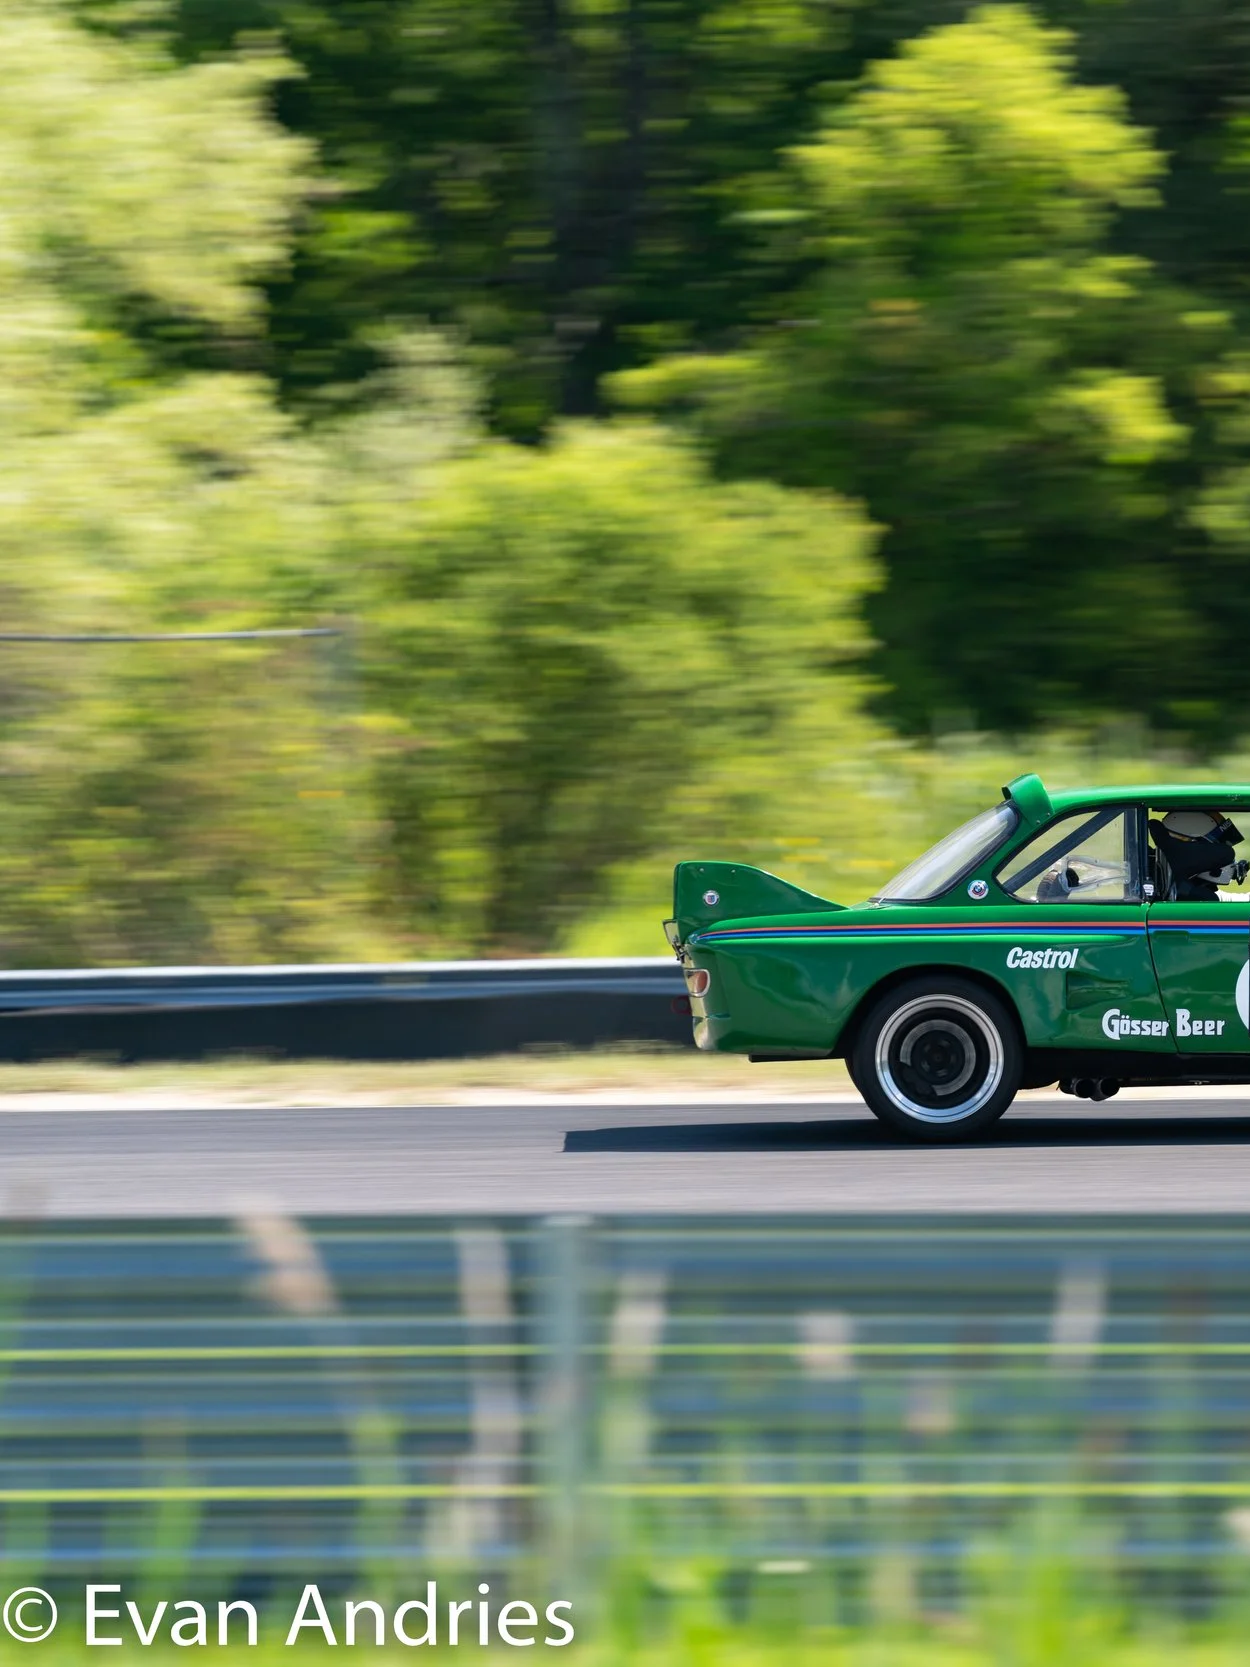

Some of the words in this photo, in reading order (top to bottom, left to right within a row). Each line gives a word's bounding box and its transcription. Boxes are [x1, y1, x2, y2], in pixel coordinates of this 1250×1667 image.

[1006, 946, 1079, 969] Castrol
[1101, 1008, 1170, 1041] Gösser
[1175, 1008, 1226, 1037] Beer
